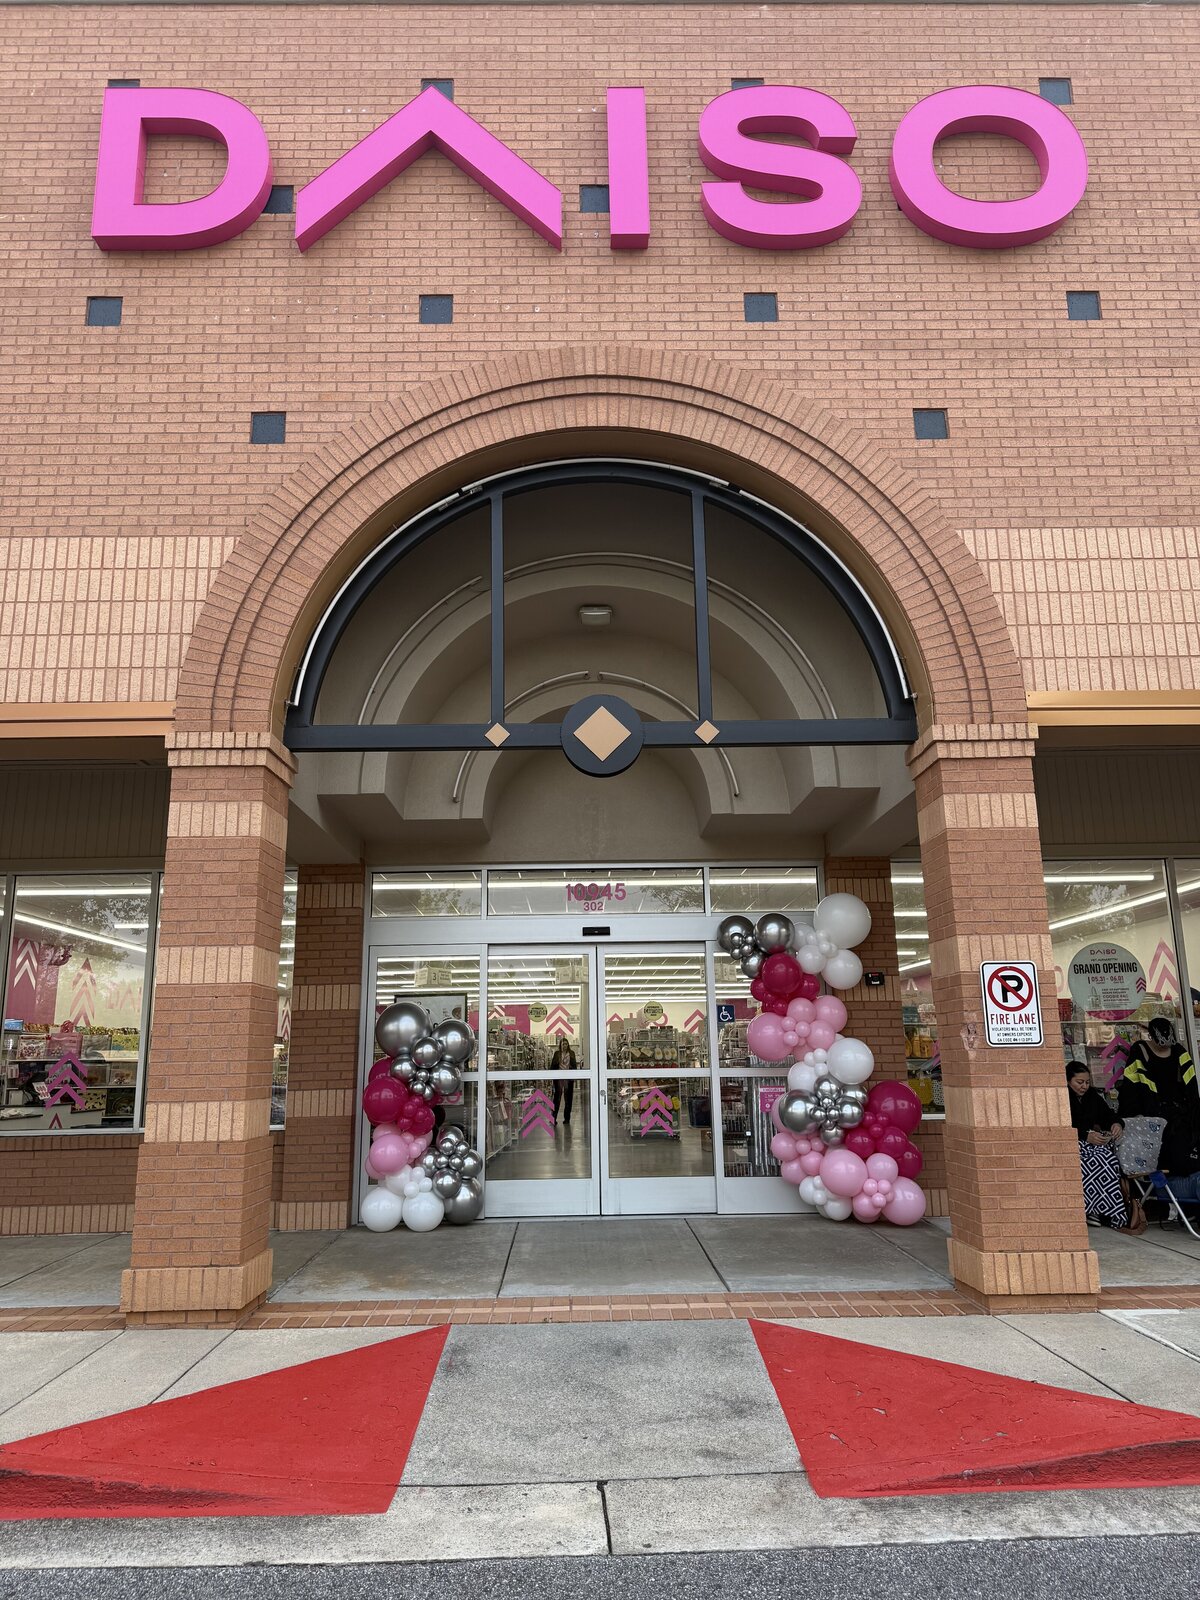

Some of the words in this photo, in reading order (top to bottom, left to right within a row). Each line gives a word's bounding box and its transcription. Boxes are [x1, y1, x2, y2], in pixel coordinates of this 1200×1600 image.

[91, 84, 1089, 252] DAISO
[565, 882, 627, 902] 10945
[583, 901, 604, 912] 302
[1089, 948, 1117, 956] DAISO
[1073, 963, 1101, 975] GRAND
[1103, 962, 1138, 974] OPENING
[990, 1013, 1011, 1025] FIRE
[1012, 1013, 1037, 1025] LANE
